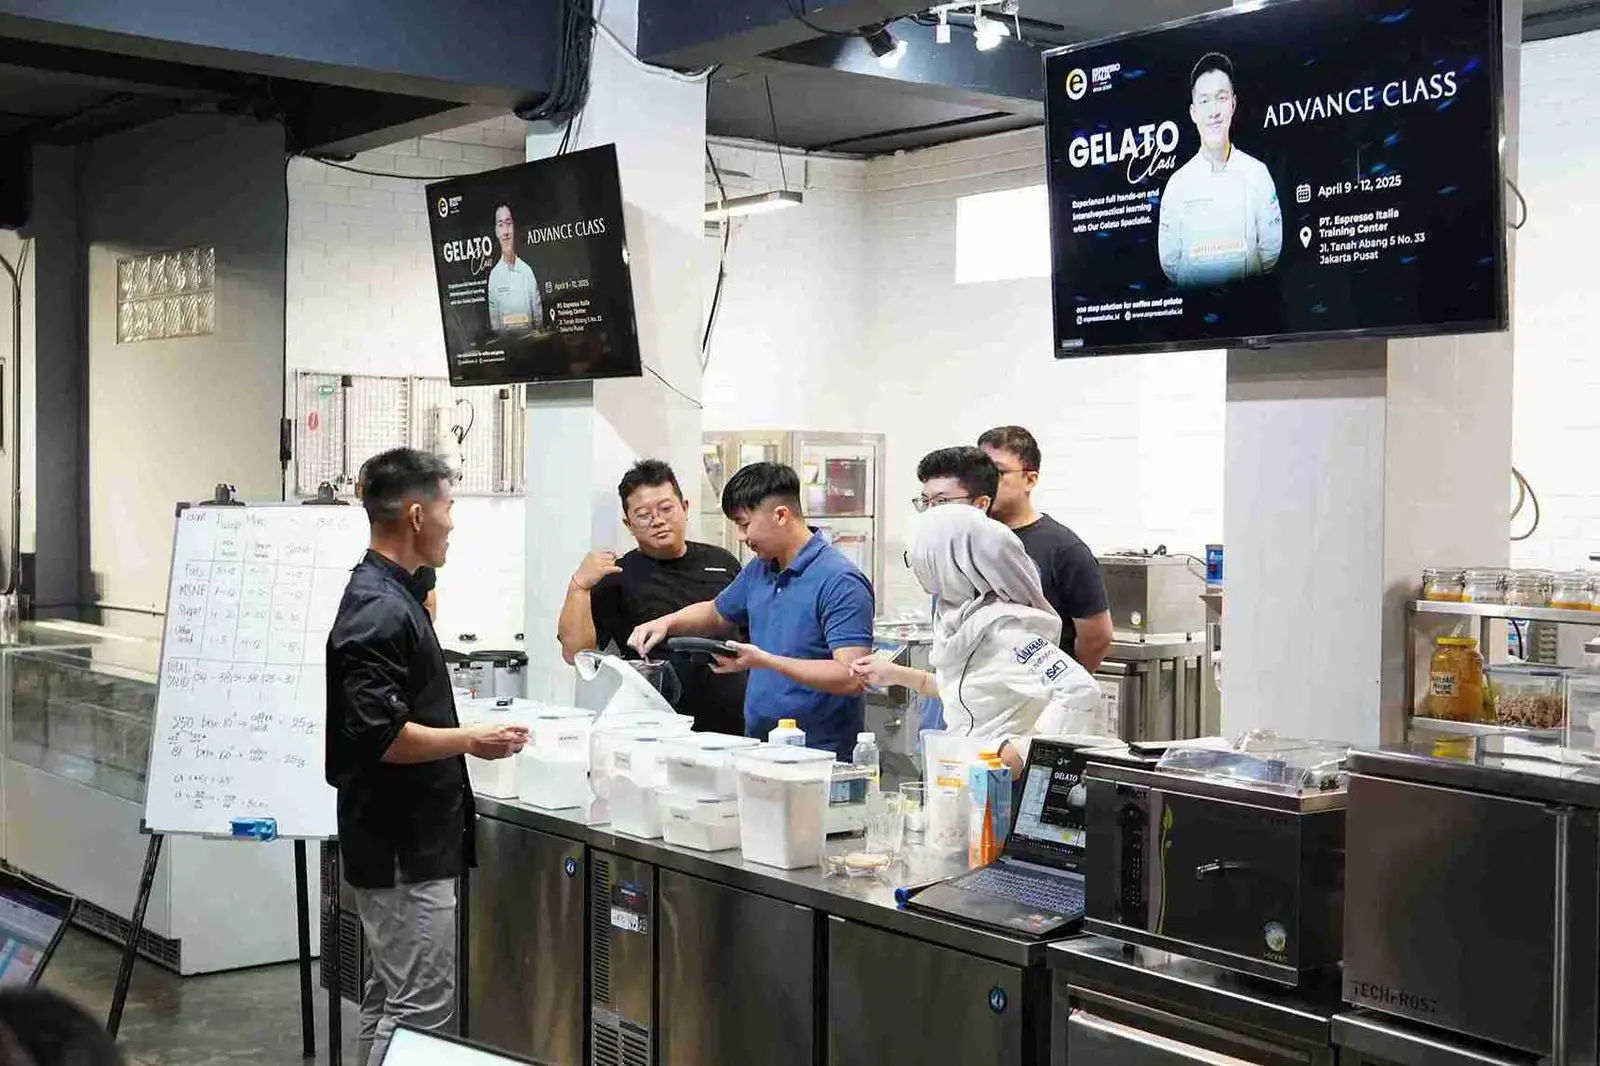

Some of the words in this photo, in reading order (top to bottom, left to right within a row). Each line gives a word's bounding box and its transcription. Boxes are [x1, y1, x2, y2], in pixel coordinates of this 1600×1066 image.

[1263, 87, 1375, 129] ADVANCE
[1382, 71, 1458, 107] CLASS
[1068, 121, 1180, 168] GELATO
[1126, 140, 1177, 184] Class
[1318, 182, 1342, 198] April
[1344, 182, 1352, 194] 9
[1360, 179, 1374, 191] 12,
[1375, 175, 1402, 189] 2025
[1072, 197, 1105, 209] Experience
[1105, 194, 1116, 204] full
[1117, 191, 1146, 202] hands-on
[1147, 187, 1160, 198] and
[1125, 202, 1152, 214] learning
[1072, 224, 1087, 233] with
[1087, 222, 1099, 232] Our
[1099, 220, 1120, 230] Gelato
[1319, 216, 1333, 227] PT.
[1334, 212, 1374, 226] Espresso
[1375, 208, 1399, 220] Italia
[527, 223, 573, 245] ADVANCE
[574, 217, 606, 237] CLASS
[1319, 225, 1355, 238] Training
[1357, 223, 1388, 233] Center
[443, 236, 492, 263] GELATO
[1319, 243, 1329, 253] Jl.
[1330, 240, 1357, 252] Tanah
[1358, 238, 1388, 249] Abang
[1389, 235, 1395, 246] 5
[1397, 234, 1412, 245] No.
[1413, 232, 1426, 243] 33
[1319, 253, 1352, 265] Jakarta
[1353, 250, 1379, 261] Pusat
